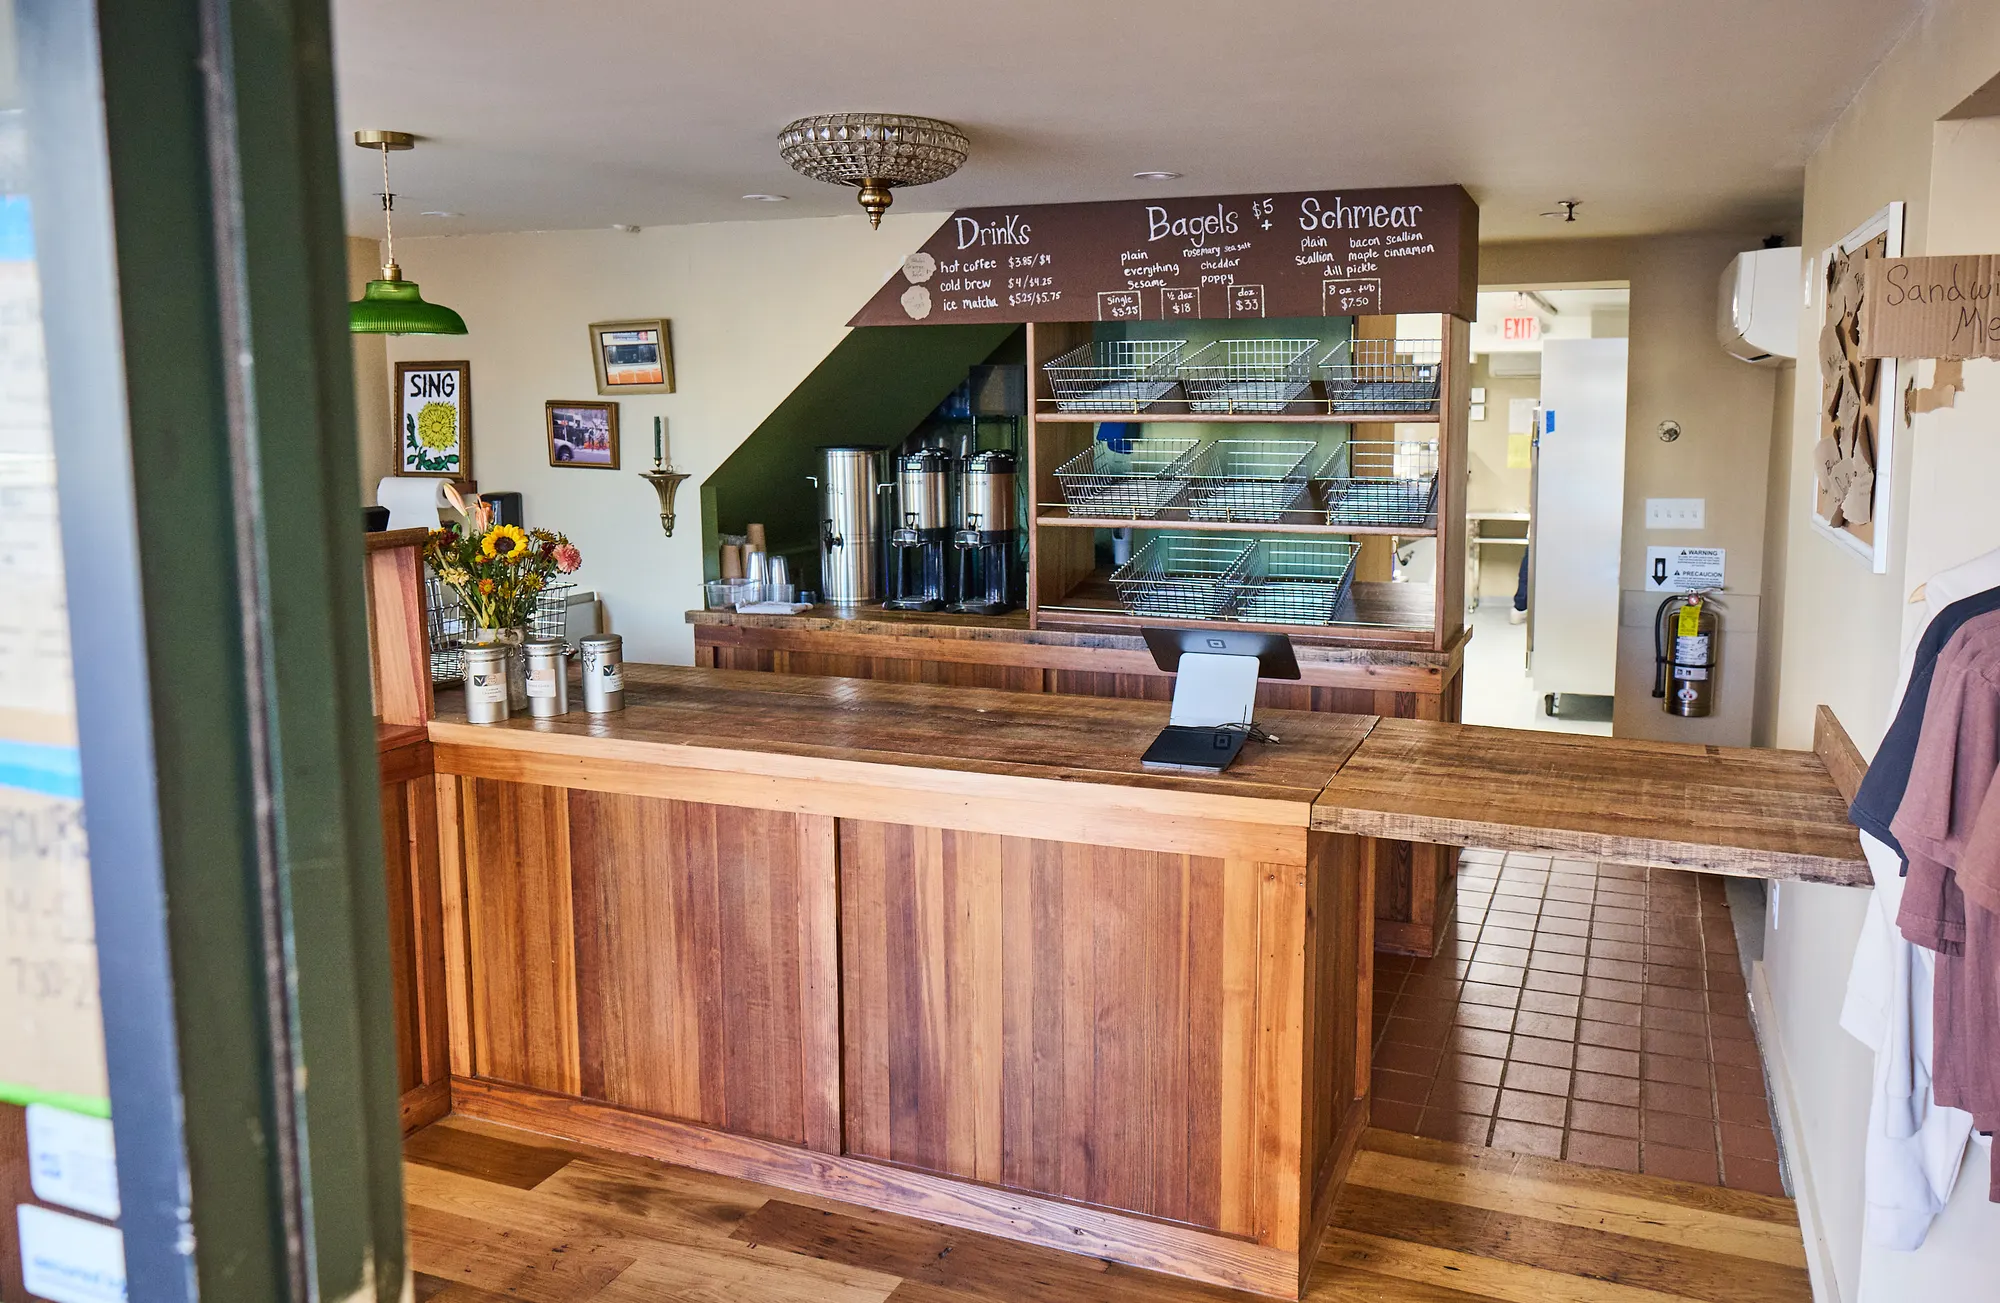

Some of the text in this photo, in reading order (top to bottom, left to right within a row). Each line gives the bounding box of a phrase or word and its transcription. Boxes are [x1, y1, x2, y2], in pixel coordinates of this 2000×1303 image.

[1252, 198, 1274, 219] $5
[1299, 197, 1423, 231] Schmear
[1145, 203, 1239, 247] Bagels
[1301, 236, 1328, 252] plain
[1349, 231, 1423, 248] bacon scallion
[1121, 249, 1149, 266] plain
[1183, 241, 1252, 259] rosemary sea salt
[1348, 243, 1435, 262] maple cinnamon
[940, 259, 960, 273] hot
[963, 258, 997, 273] coffee
[1200, 257, 1240, 270] cheddar
[1295, 252, 1335, 266] scallion
[1124, 262, 1180, 277] everything
[1323, 262, 1378, 278] dill pickle
[940, 278, 960, 292] cold
[964, 278, 991, 290] brew
[1201, 273, 1234, 288] poppy
[1329, 284, 1336, 294] 8
[1358, 284, 1376, 294] tub
[943, 298, 958, 311] ice
[962, 294, 999, 309] matcha
[1172, 302, 1191, 314] $18
[1235, 299, 1259, 311] $33
[1340, 297, 1369, 311] $7.50
[1112, 305, 1139, 317] $3.25
[1504, 317, 1534, 340] EXIT
[410, 372, 455, 398] SING
